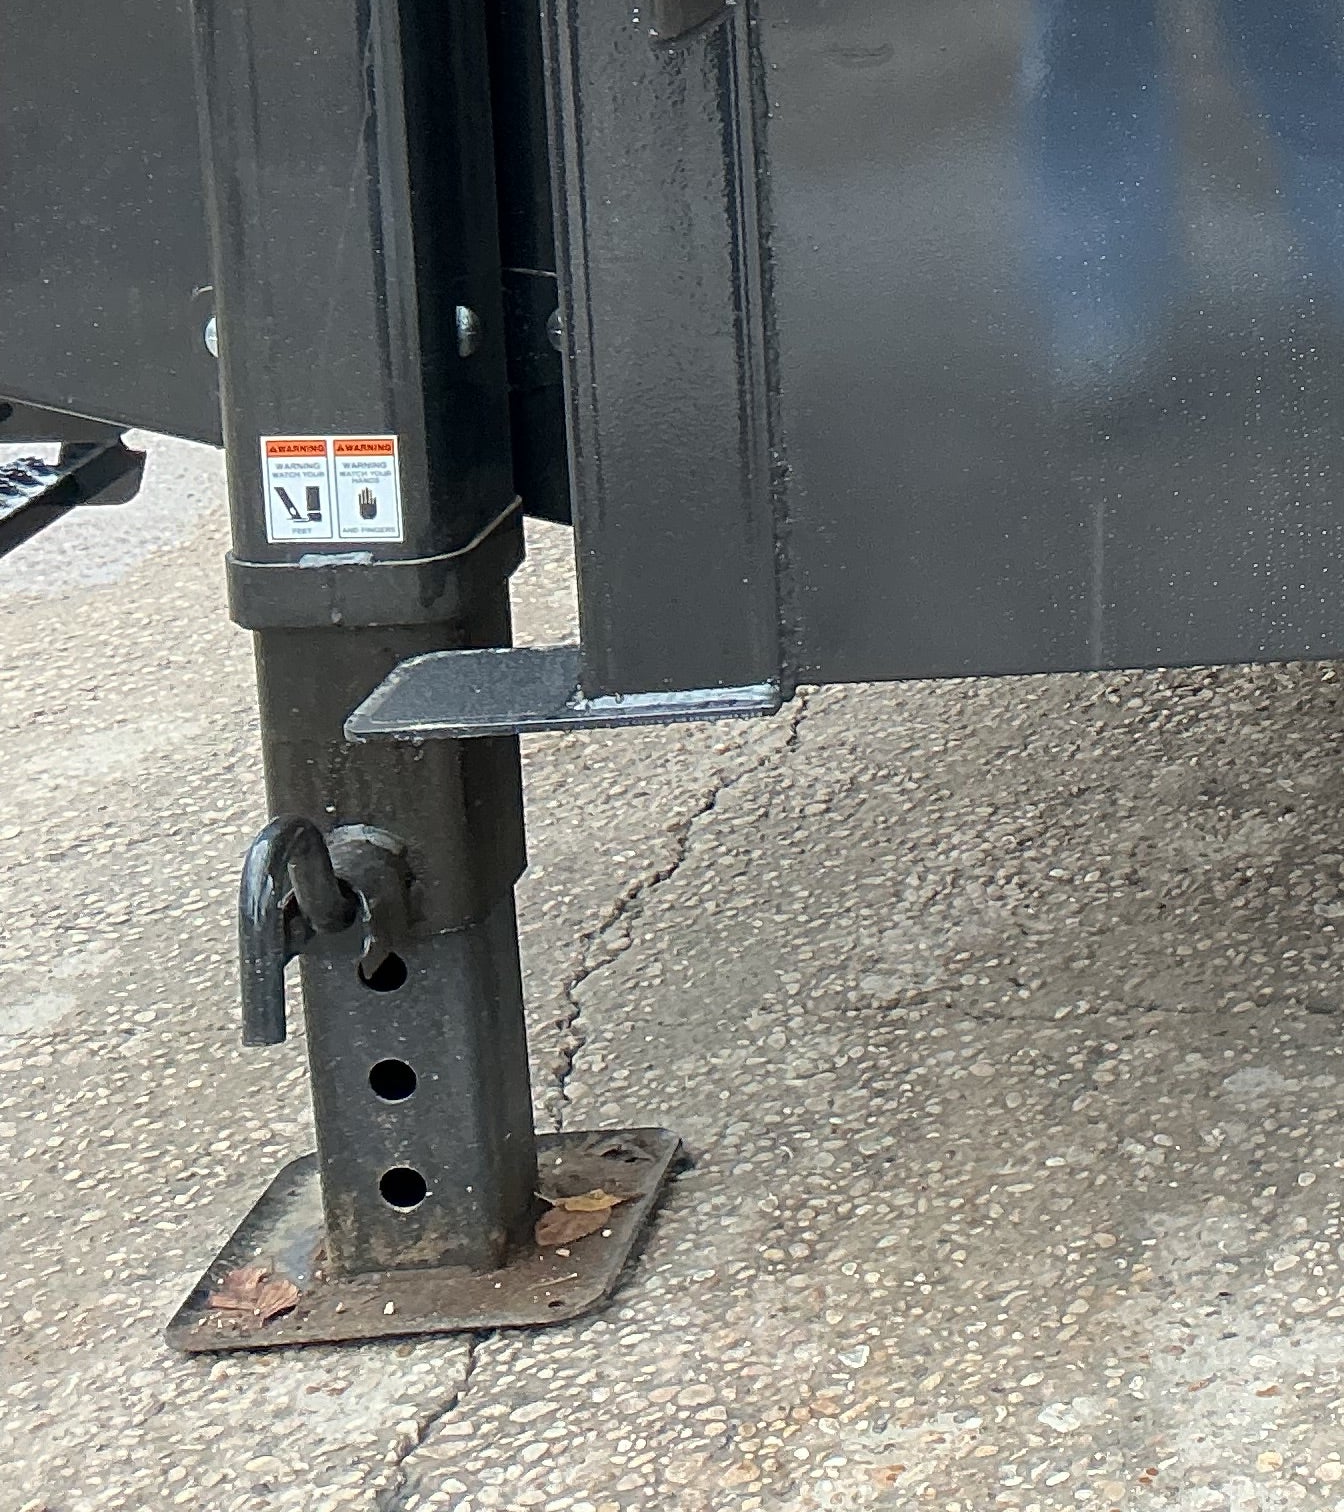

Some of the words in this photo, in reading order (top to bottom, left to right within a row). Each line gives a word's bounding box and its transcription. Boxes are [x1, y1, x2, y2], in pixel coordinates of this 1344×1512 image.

[278, 445, 325, 453] WARNING
[345, 444, 392, 452] WARNING
[275, 462, 321, 470] WARNING
[342, 461, 387, 469] WARNING
